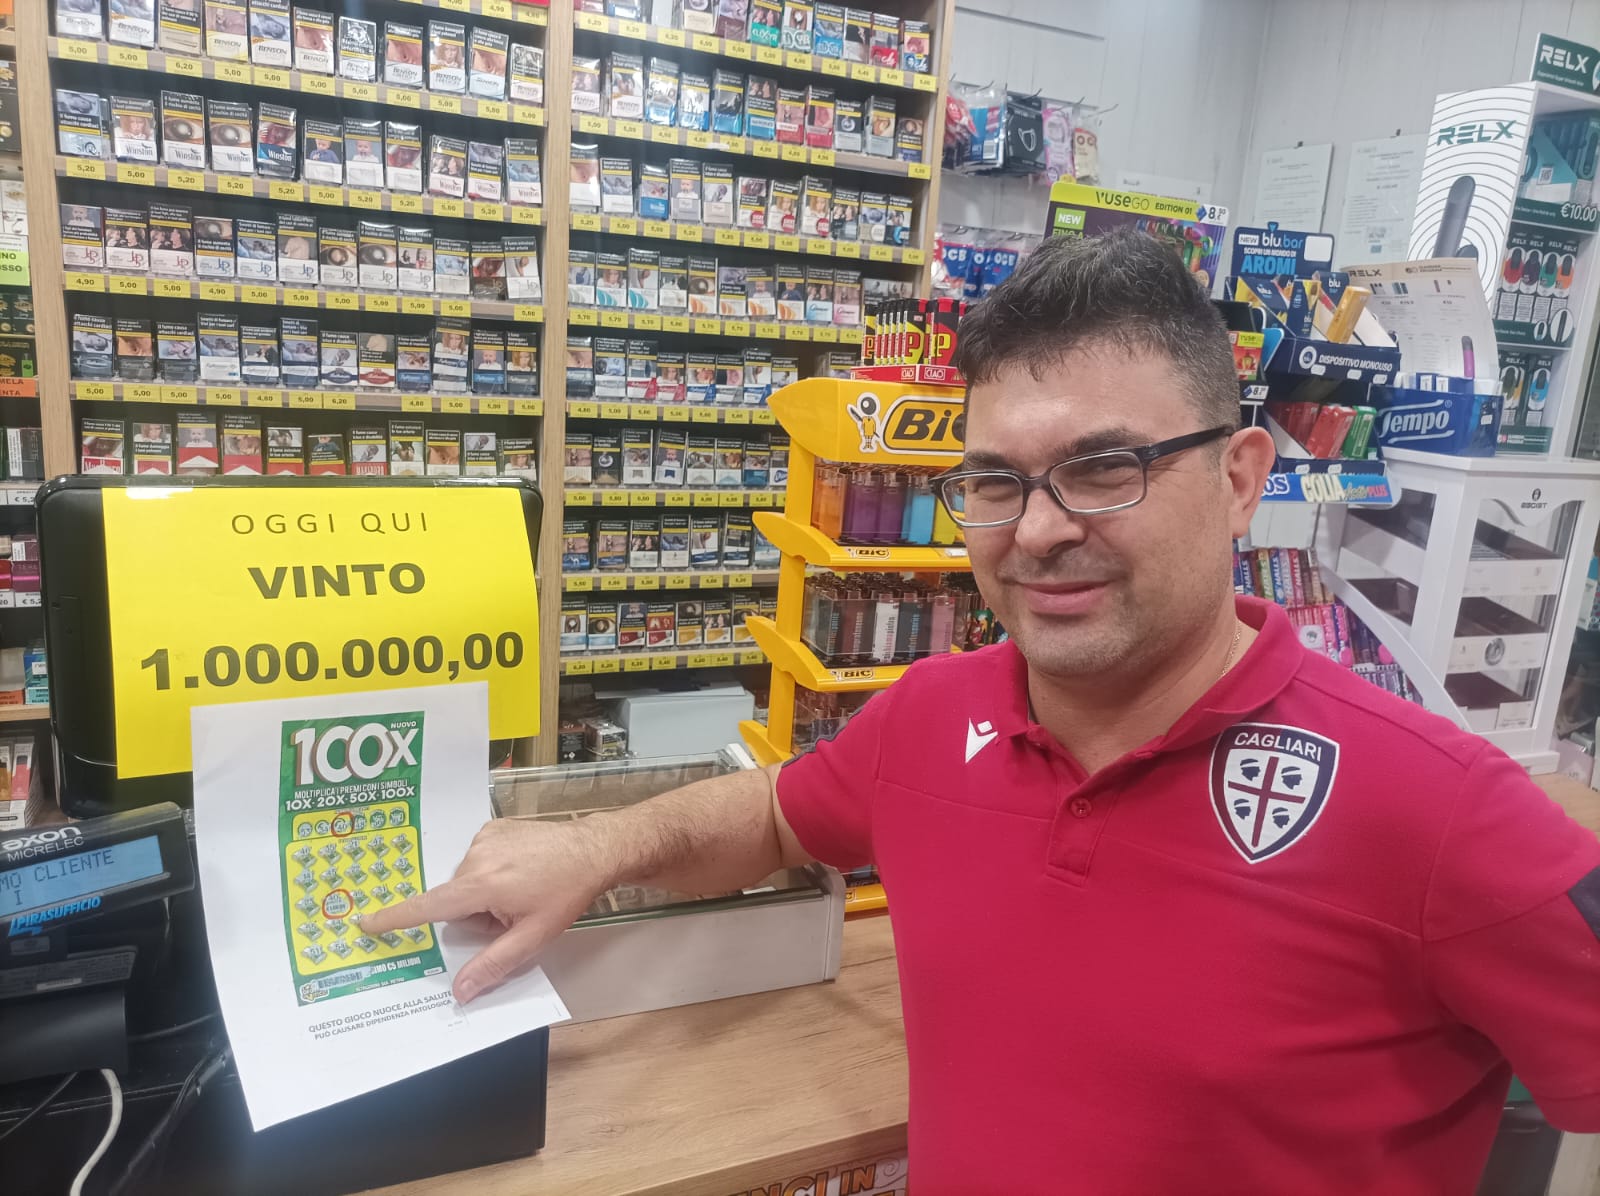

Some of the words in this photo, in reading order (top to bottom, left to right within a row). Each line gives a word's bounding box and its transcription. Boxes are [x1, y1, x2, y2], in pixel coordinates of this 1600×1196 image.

[69, 46, 87, 54] 5,00
[120, 53, 137, 61] 5,00
[1540, 44, 1590, 74] RELX
[1437, 120, 1516, 146] RELX
[177, 176, 195, 184] 5,20
[1058, 214, 1082, 226] NEW
[1155, 203, 1184, 214] EDITION
[1561, 202, 1597, 224] €10.00
[1241, 255, 1296, 275] AROMI
[926, 369, 944, 380] CIAO
[1318, 354, 1358, 368] DISPOSITIVO
[1359, 358, 1393, 373] MONOUSO
[1380, 405, 1450, 438] Tempo
[1301, 474, 1345, 502] GOLIA
[232, 514, 335, 535] OGGI
[360, 512, 428, 535] QUI
[248, 562, 425, 600] VINTO
[140, 632, 524, 691] 1.000.000,00
[391, 721, 416, 729] NUOVO
[291, 723, 419, 786] 100X
[1234, 732, 1323, 762] CAGLIARI
[295, 788, 335, 799] MOLTIPLICA
[340, 784, 361, 795] PREMI
[362, 783, 377, 792] CON
[381, 779, 408, 790] SIMBOLI
[382, 786, 415, 798] 100X
[7, 836, 85, 862] MICRELEC
[35, 850, 115, 882] CLIENTE
[309, 1017, 342, 1033] QUESTO
[345, 1011, 372, 1024] GIOCO
[373, 1003, 402, 1017] NUOCE
[403, 999, 423, 1010] ALLA
[332, 1022, 365, 1035] CAUSARE
[366, 1012, 409, 1027] DIPENDENZA
[411, 999, 452, 1016] PATOLOGICA
